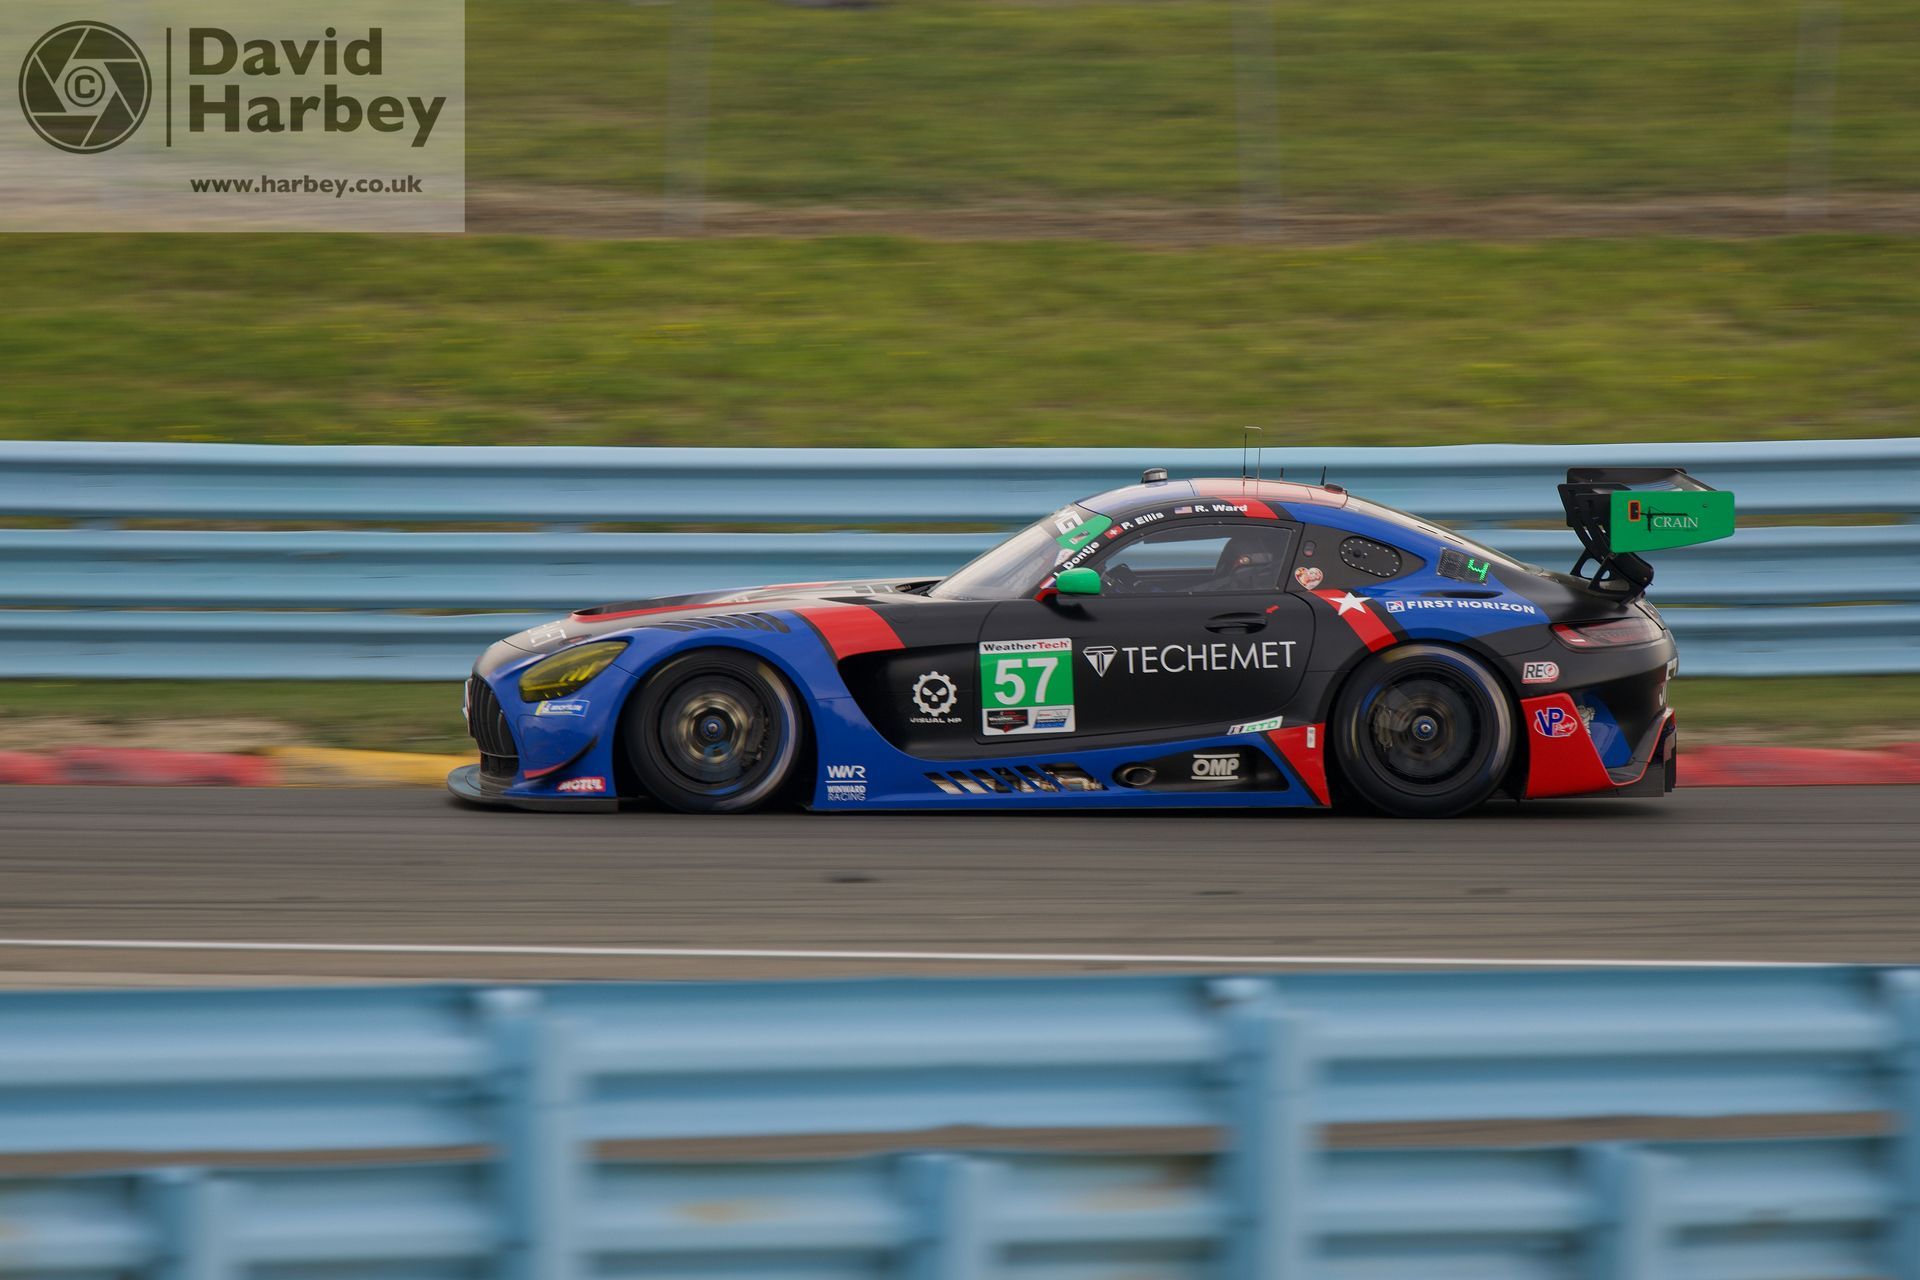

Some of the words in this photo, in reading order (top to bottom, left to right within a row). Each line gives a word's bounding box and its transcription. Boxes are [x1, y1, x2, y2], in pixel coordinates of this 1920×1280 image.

[1194, 505, 1209, 513] R.
[1211, 503, 1248, 513] Ward
[1135, 511, 1165, 526] Ellis
[1653, 516, 1698, 528] CRAIN
[1062, 541, 1100, 571] Dontje
[1467, 558, 1490, 583] 4
[1407, 600, 1454, 610] FIRST
[1457, 600, 1536, 615] HORIZON
[983, 640, 1069, 652] WeatherTech
[1121, 640, 1296, 674] TECHEMET
[993, 657, 1059, 705] 57
[1246, 720, 1278, 732] GTD
[1535, 707, 1565, 737] VP
[1191, 758, 1240, 777] OMP
[828, 792, 866, 801] RACING
